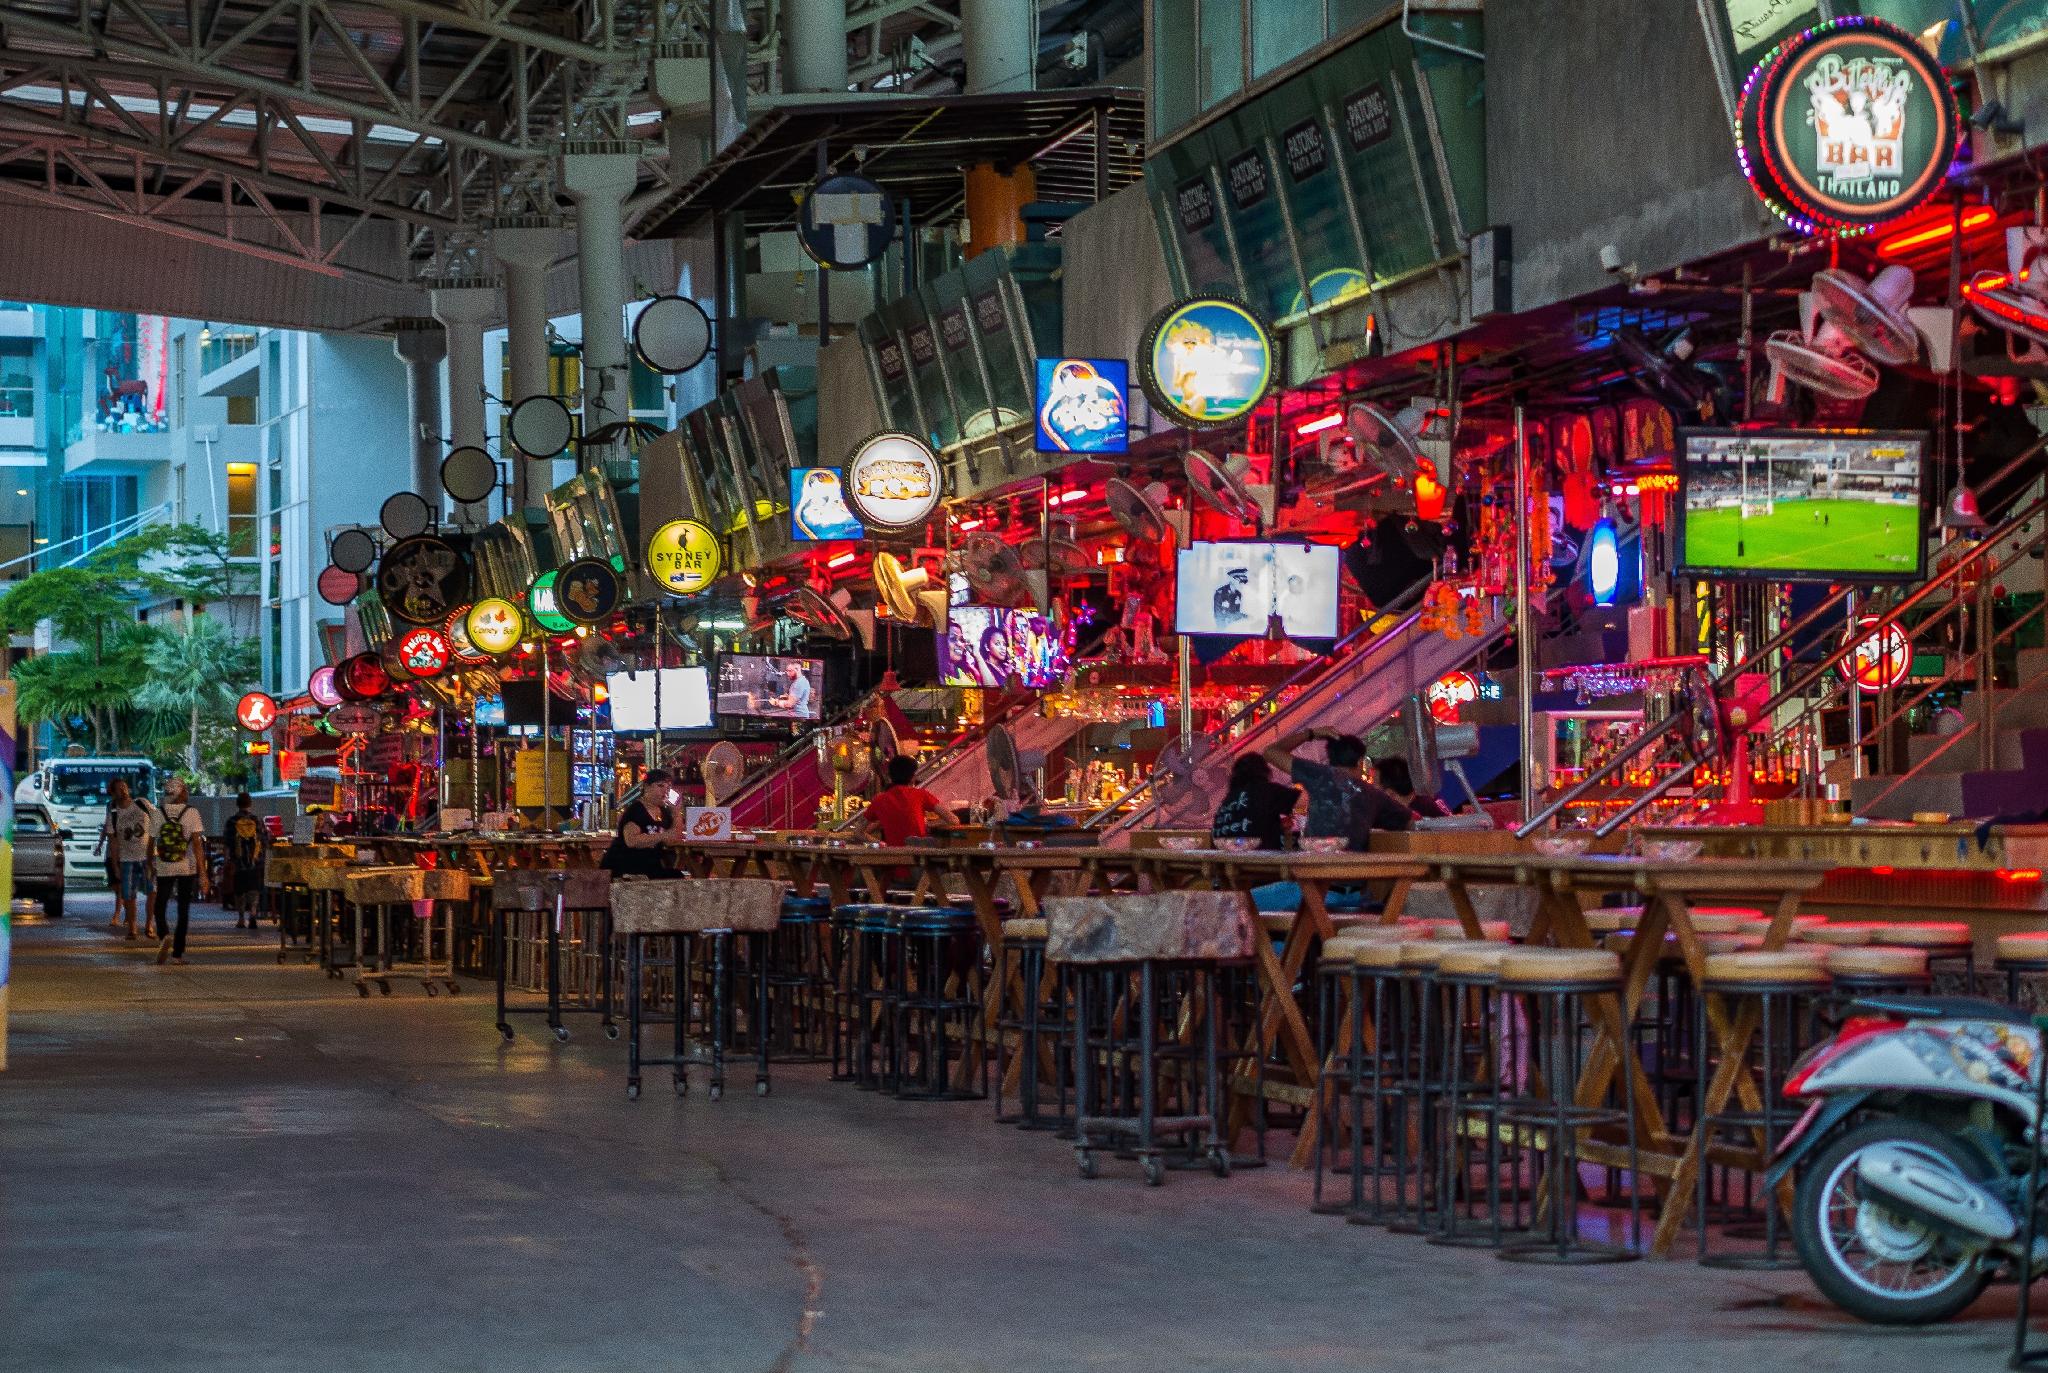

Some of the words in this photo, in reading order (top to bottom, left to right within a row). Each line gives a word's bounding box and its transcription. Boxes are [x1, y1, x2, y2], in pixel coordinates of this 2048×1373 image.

[1825, 143, 1893, 166] BAR
[1817, 176, 1900, 199] THAILAND
[656, 552, 711, 561] SYDNEY
[674, 561, 702, 569] BAR
